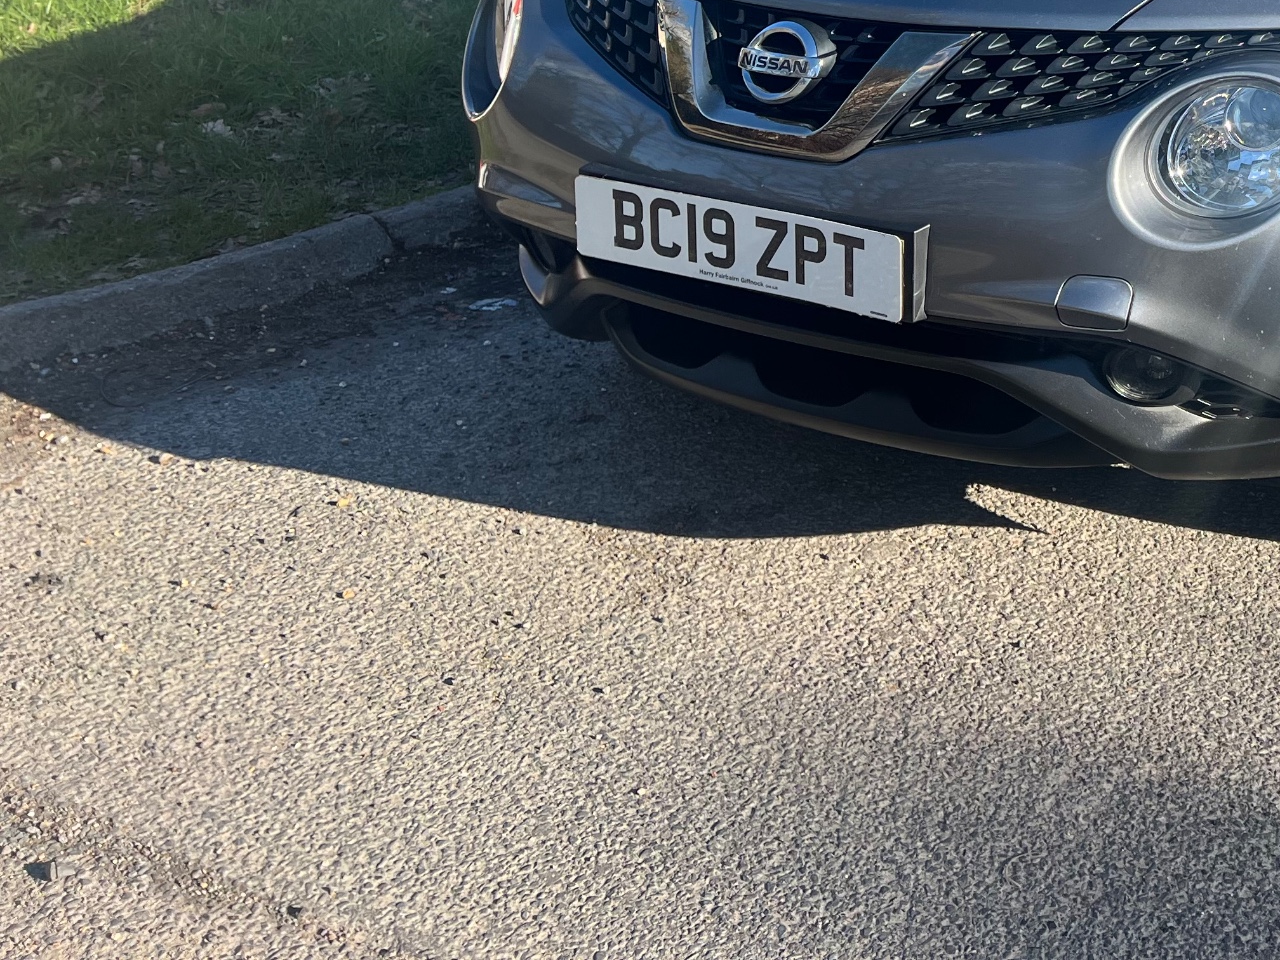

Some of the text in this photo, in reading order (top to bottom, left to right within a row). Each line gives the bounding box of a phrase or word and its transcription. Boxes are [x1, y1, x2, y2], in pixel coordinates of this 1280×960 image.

[740, 51, 808, 74] NISSAN
[612, 188, 865, 298] BC19 ZPT
[699, 269, 715, 277] Harry
[715, 272, 740, 282] Fairbairn
[740, 277, 765, 288] Giffnock
